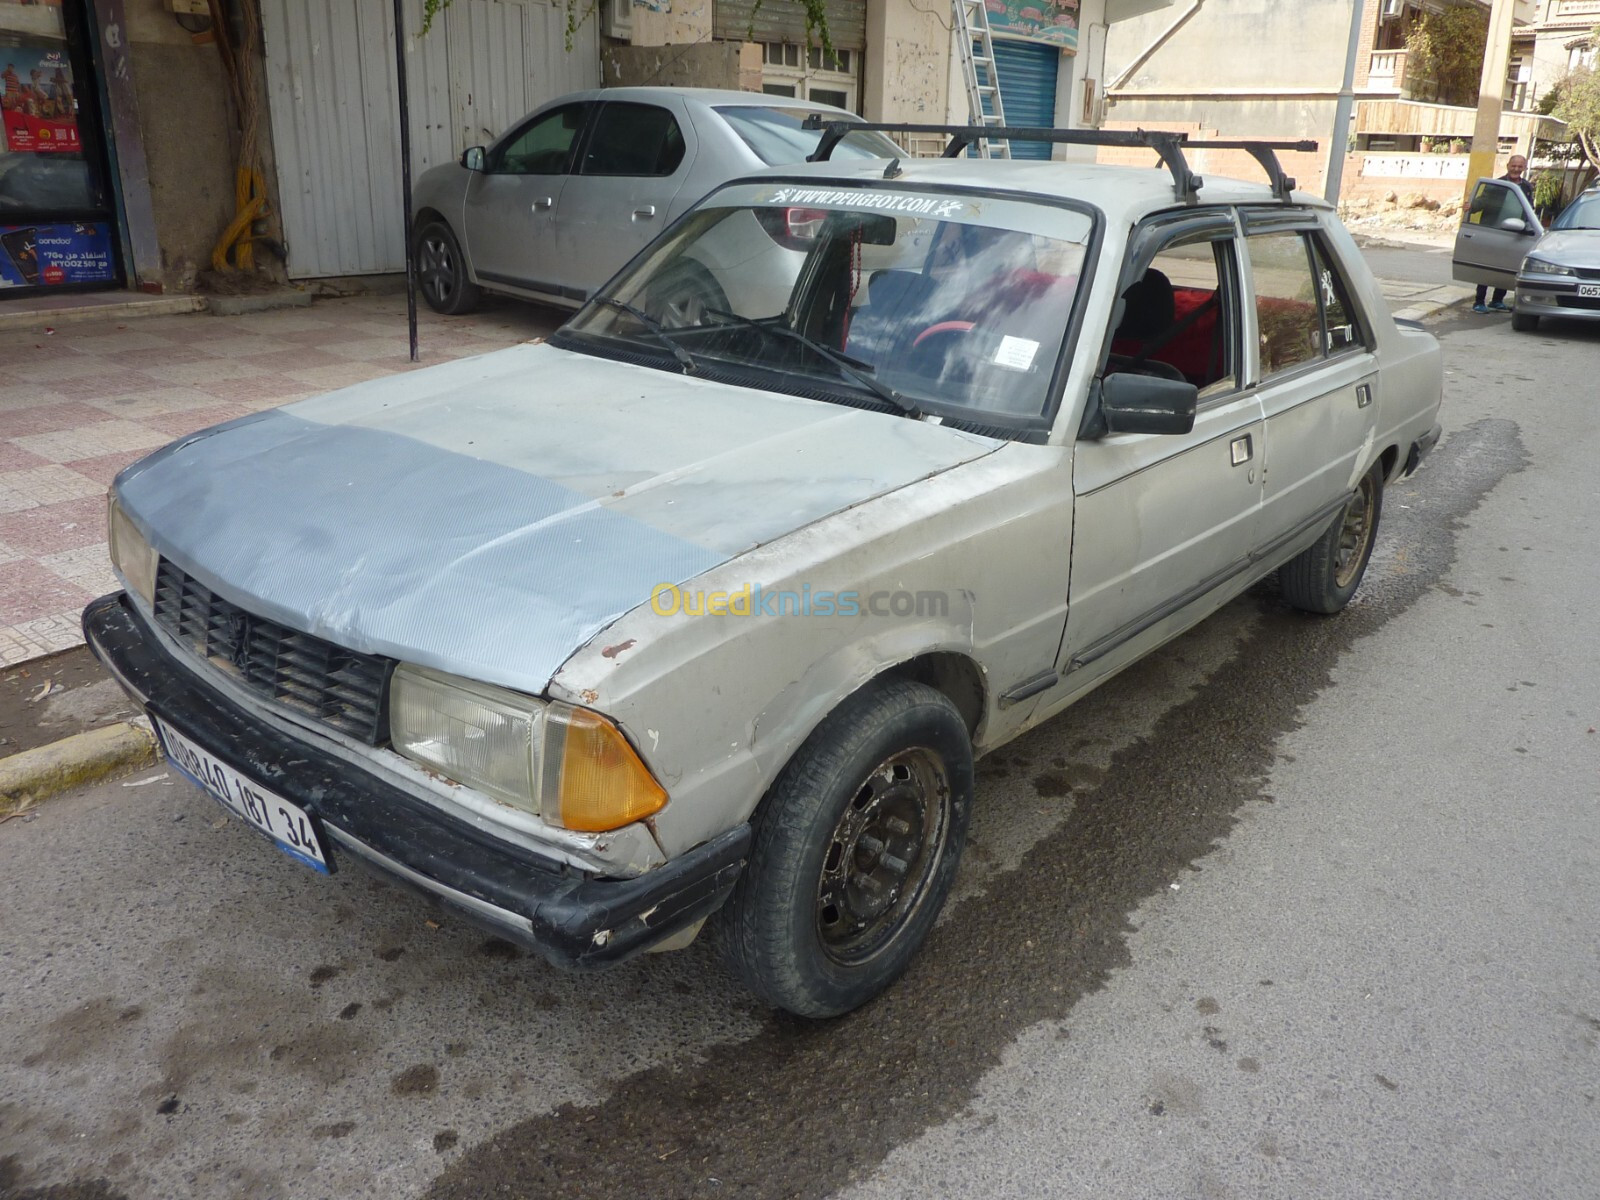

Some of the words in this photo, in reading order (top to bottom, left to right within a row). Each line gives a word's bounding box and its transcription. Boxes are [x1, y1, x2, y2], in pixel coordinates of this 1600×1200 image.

[790, 188, 939, 214] WWW.PEUGEOT.COM
[38, 237, 71, 245] ooredoo
[1580, 286, 1600, 296] 065
[235, 778, 274, 833] 187
[278, 807, 318, 857] 34
